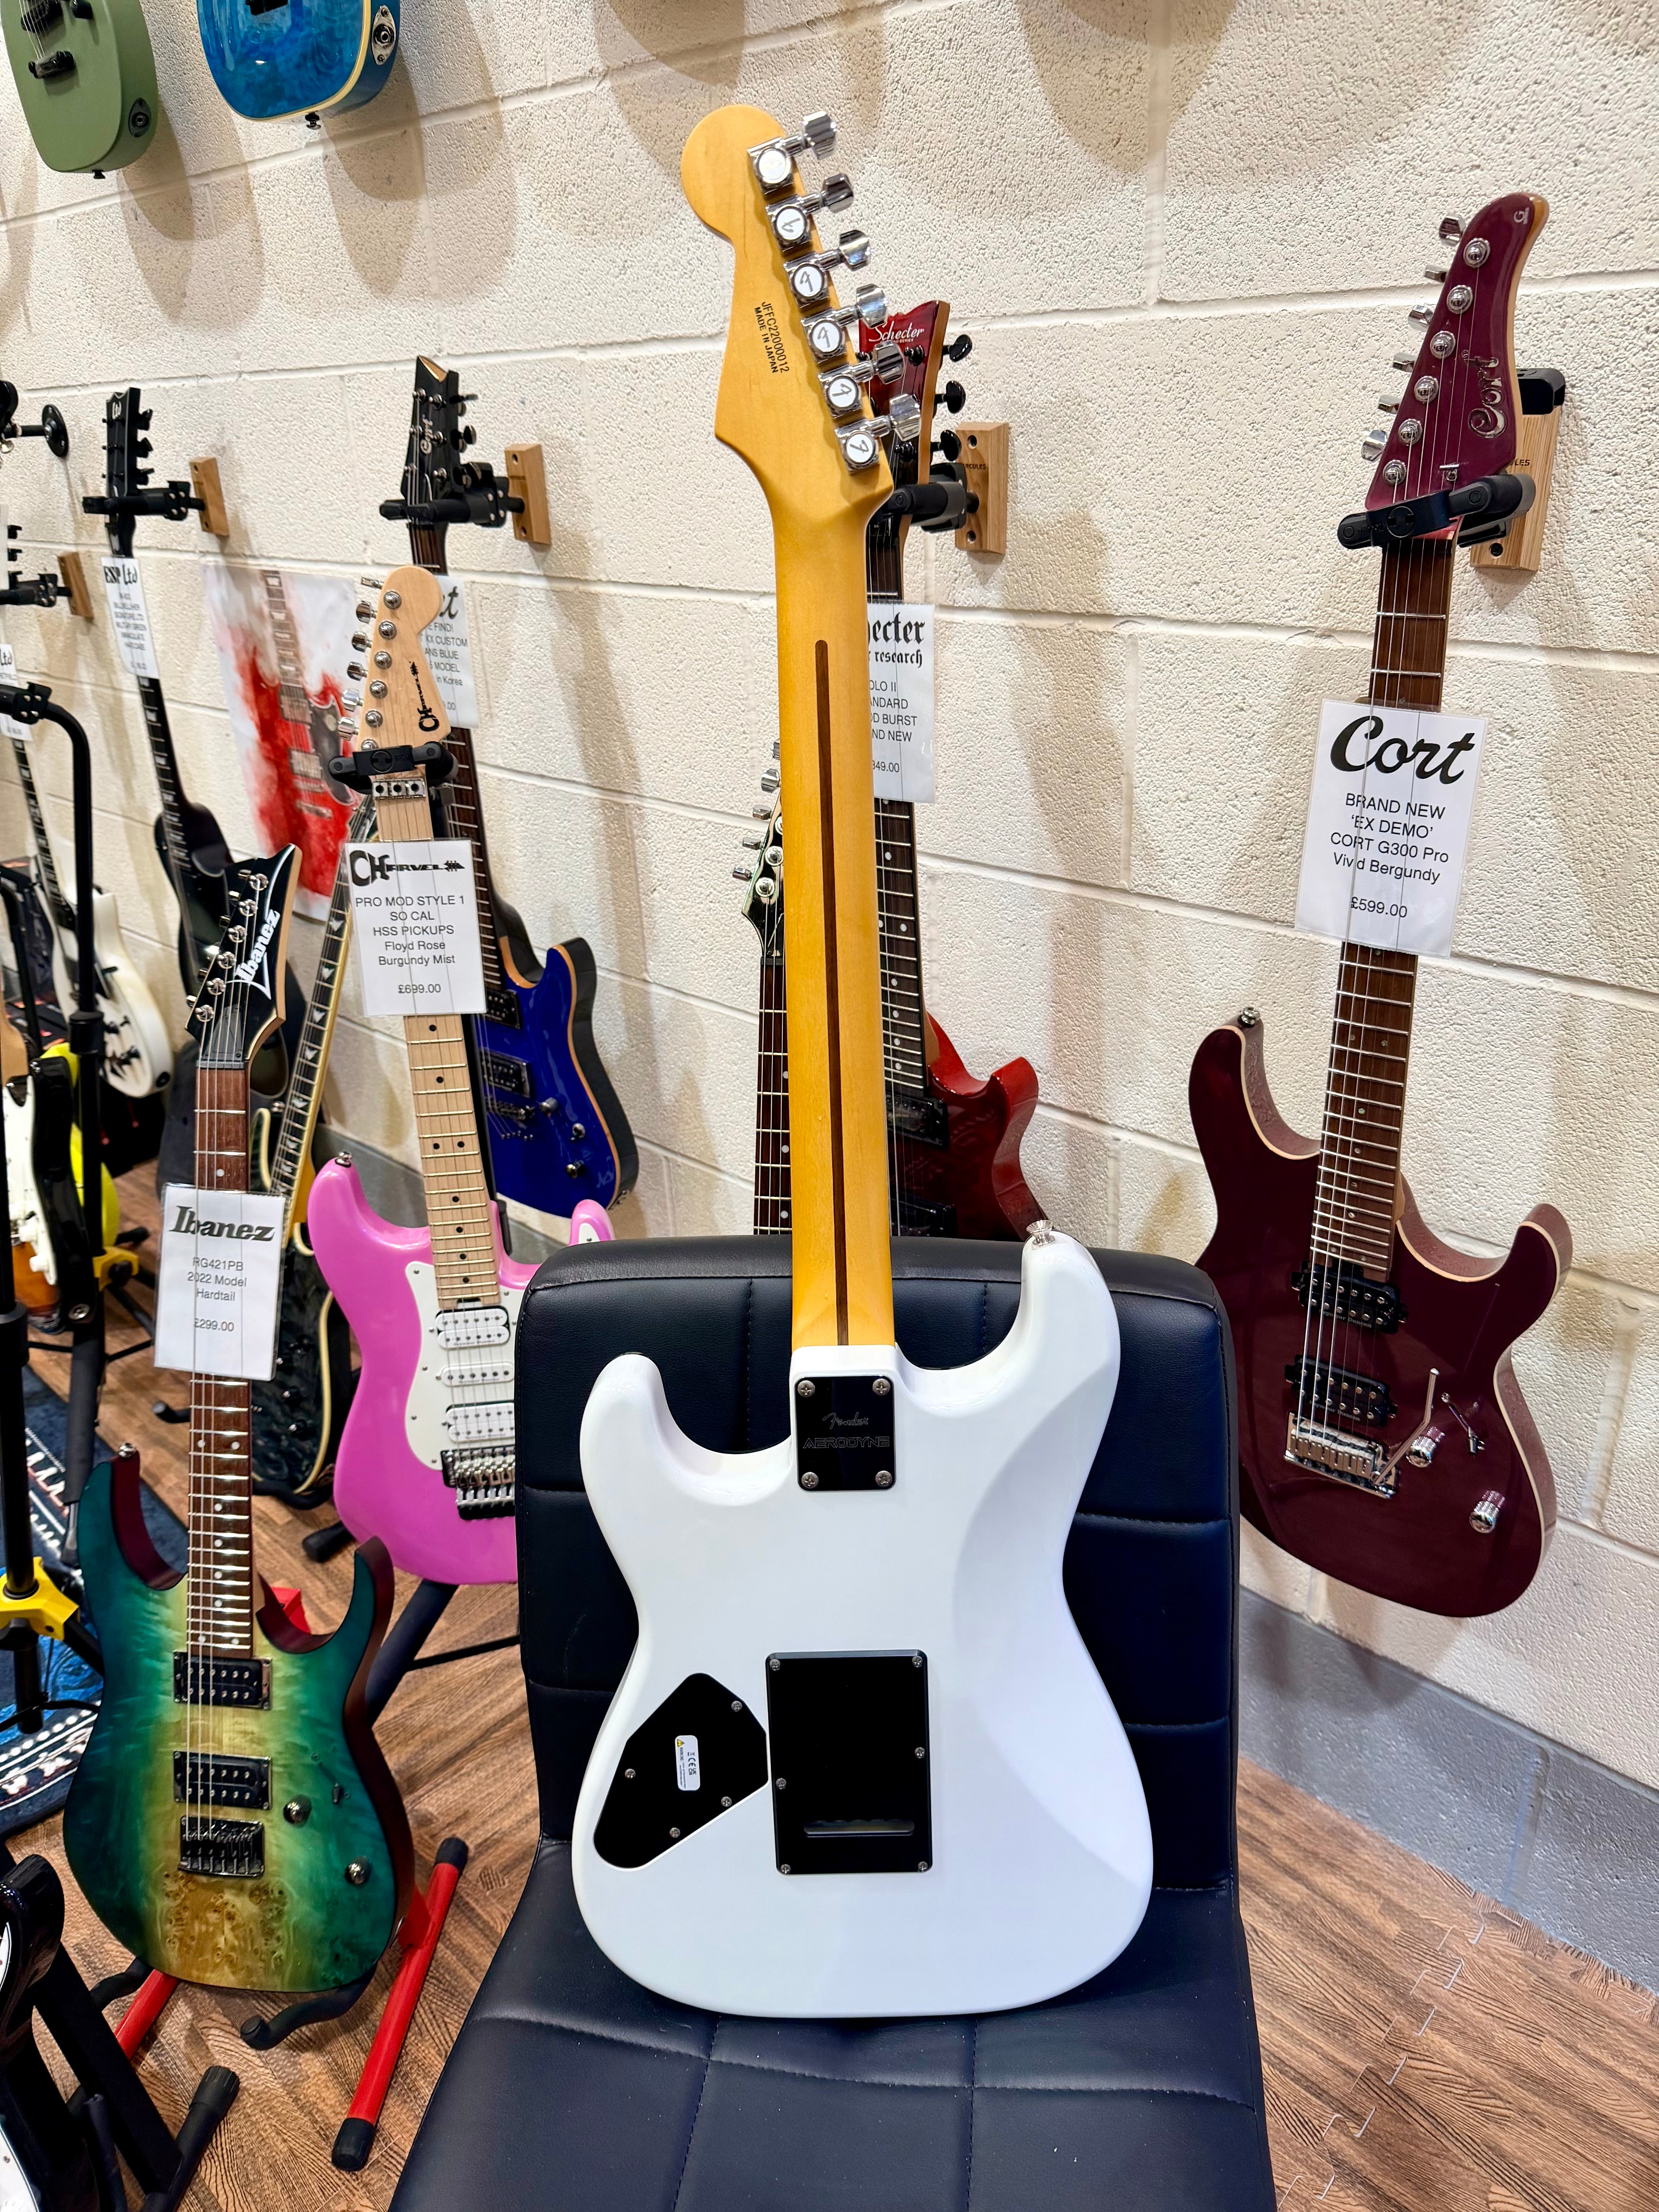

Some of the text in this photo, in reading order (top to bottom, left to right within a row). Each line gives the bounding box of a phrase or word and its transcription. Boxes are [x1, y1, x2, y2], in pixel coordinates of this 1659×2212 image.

[761, 302, 790, 373] JFFC22000012
[869, 321, 925, 342] Schecter
[754, 307, 778, 373] MADE IN JAPAN
[868, 612, 925, 644] ecter
[436, 635, 468, 647] CUSTOM
[439, 649, 459, 659] BLUE
[875, 649, 922, 668] research
[434, 661, 460, 673] MODEL
[443, 676, 463, 686] Korea
[871, 697, 908, 709] NDARD
[882, 714, 917, 726] BURST
[888, 730, 912, 742] NEW
[1330, 715, 1475, 785] Cort
[1346, 793, 1446, 819] BRAND NEW
[1331, 832, 1449, 863] CORT G300 Pro
[1369, 860, 1440, 884] Bergundy
[356, 895, 464, 907] PRO MOD STYLE 1
[1350, 896, 1407, 918] £599.00
[390, 911, 434, 921] SO CAL
[373, 925, 454, 936] HSS PICKUPS
[235, 909, 280, 982] Ibanez
[385, 941, 445, 953] Floyd Rose
[379, 955, 455, 967] Burgundy Mist
[398, 984, 441, 994] £699.00
[169, 1205, 275, 1242] Ibanez
[193, 1257, 244, 1271] RG421PB
[187, 1272, 247, 1287] 2022 Model
[196, 1288, 235, 1301] Hardtail
[194, 1318, 234, 1332] £299.00
[822, 1412, 869, 1429] Fender
[803, 1436, 890, 1448] AERODYNE
